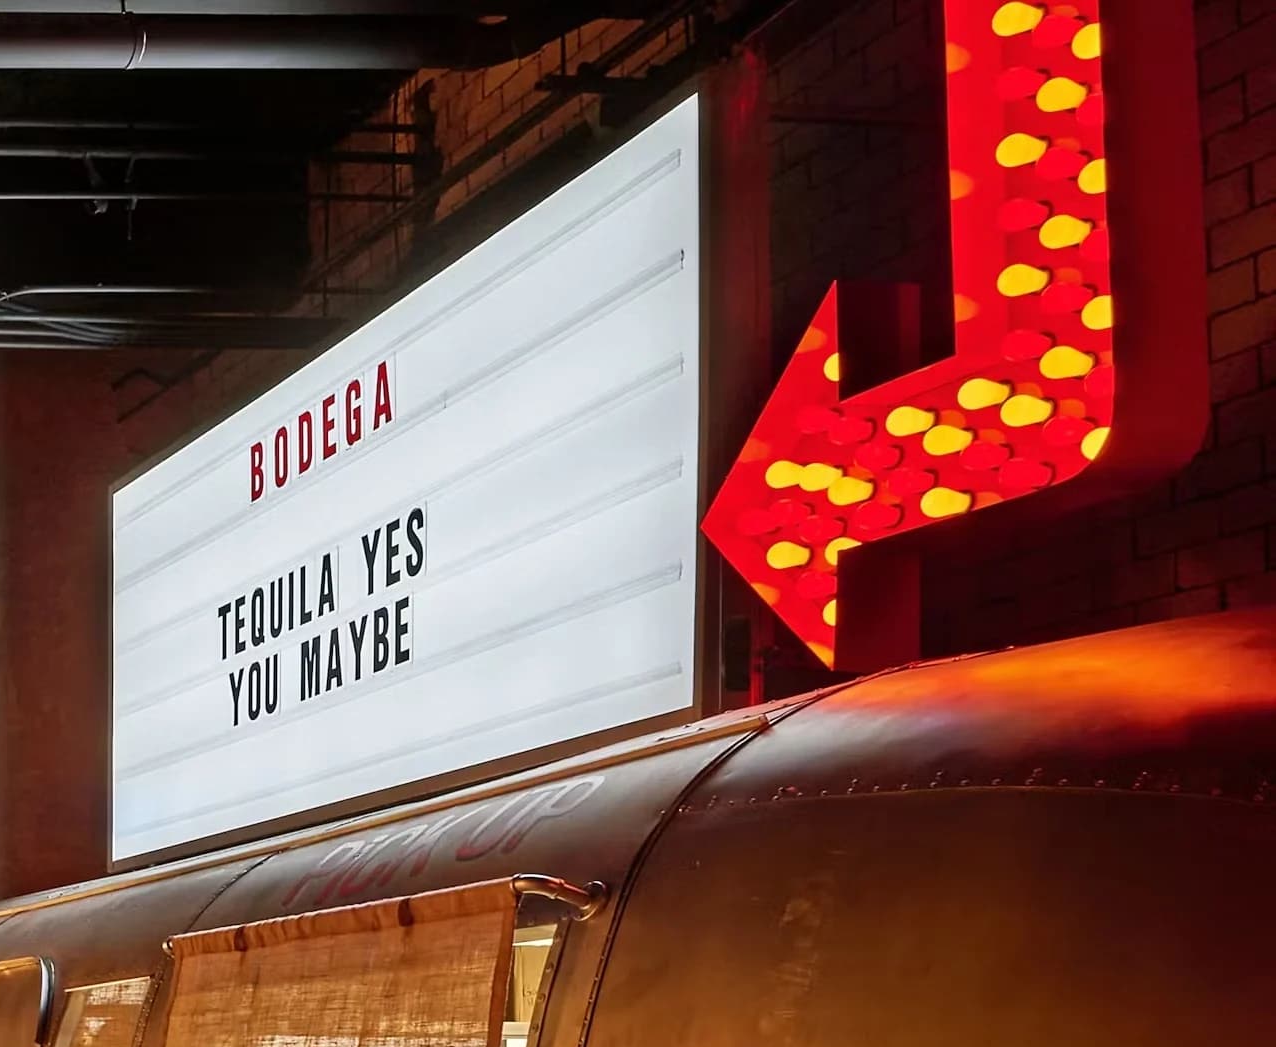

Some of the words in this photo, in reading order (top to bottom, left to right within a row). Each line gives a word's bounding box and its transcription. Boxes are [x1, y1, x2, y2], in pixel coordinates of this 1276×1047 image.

[250, 360, 394, 502] BODEGA
[217, 552, 335, 660] TEQUILA
[361, 507, 425, 596] YES
[229, 653, 279, 726] YOU
[300, 596, 411, 702] MAYBE
[457, 775, 605, 861] UP
